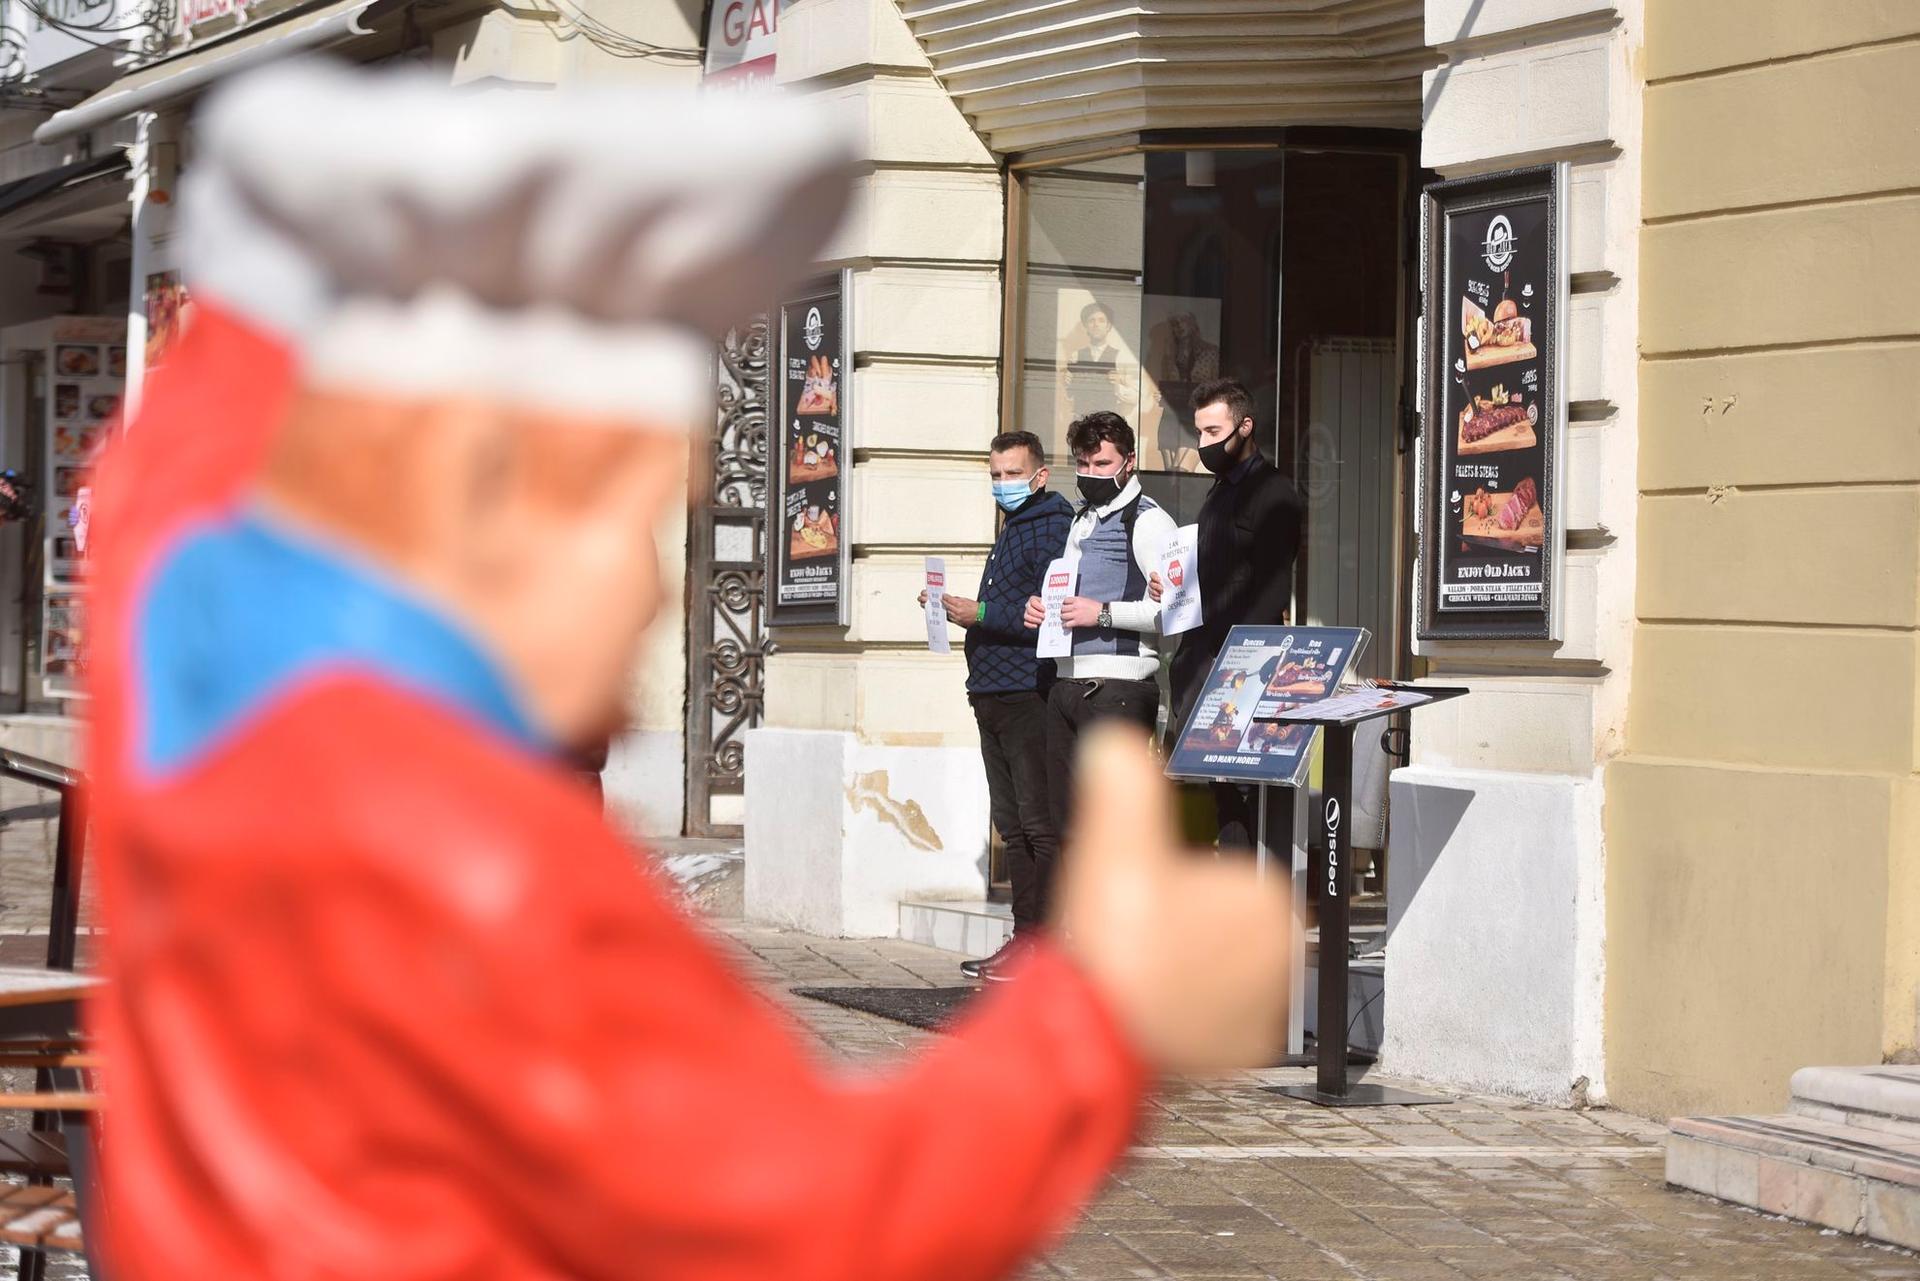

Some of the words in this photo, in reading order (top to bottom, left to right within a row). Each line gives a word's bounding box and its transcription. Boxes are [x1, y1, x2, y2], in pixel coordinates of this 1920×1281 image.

[1168, 567, 1182, 579] STOP
[1457, 567, 1483, 578] ENJOY
[1469, 585, 1483, 593] PORK
[1506, 584, 1523, 592] FILLET
[1523, 584, 1541, 592] STEAK
[1448, 594, 1472, 602] CHICKEN
[1473, 594, 1491, 602] WINGS
[1494, 594, 1520, 602] CALAMARI
[1203, 754, 1217, 763] AND
[1216, 755, 1237, 764] MANY
[1327, 830, 1338, 897] pepsi
